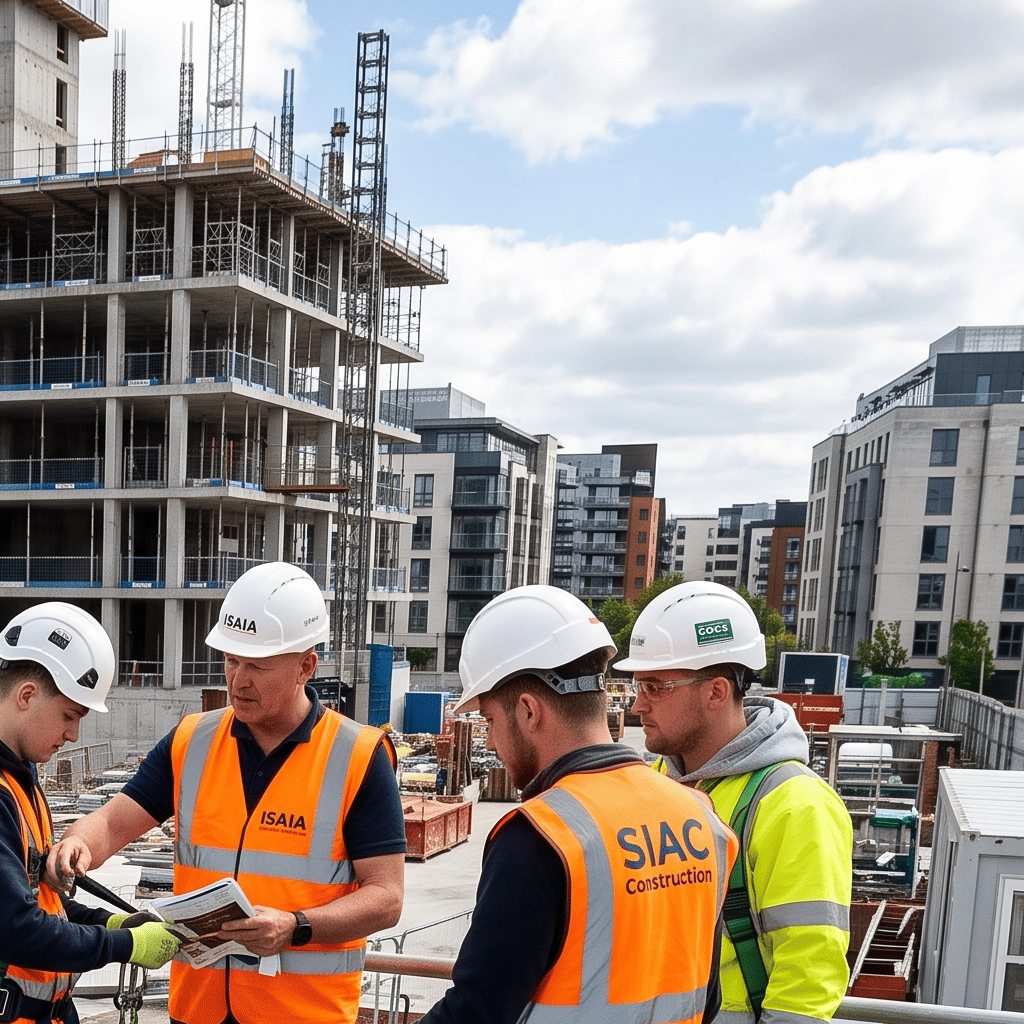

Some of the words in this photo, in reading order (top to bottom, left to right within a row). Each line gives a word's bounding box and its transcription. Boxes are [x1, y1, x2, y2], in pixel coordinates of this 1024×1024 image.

[224, 613, 257, 634] ISAIA
[260, 811, 306, 830] ISAIA
[617, 818, 710, 870] SIAC
[625, 866, 712, 895] Construction
